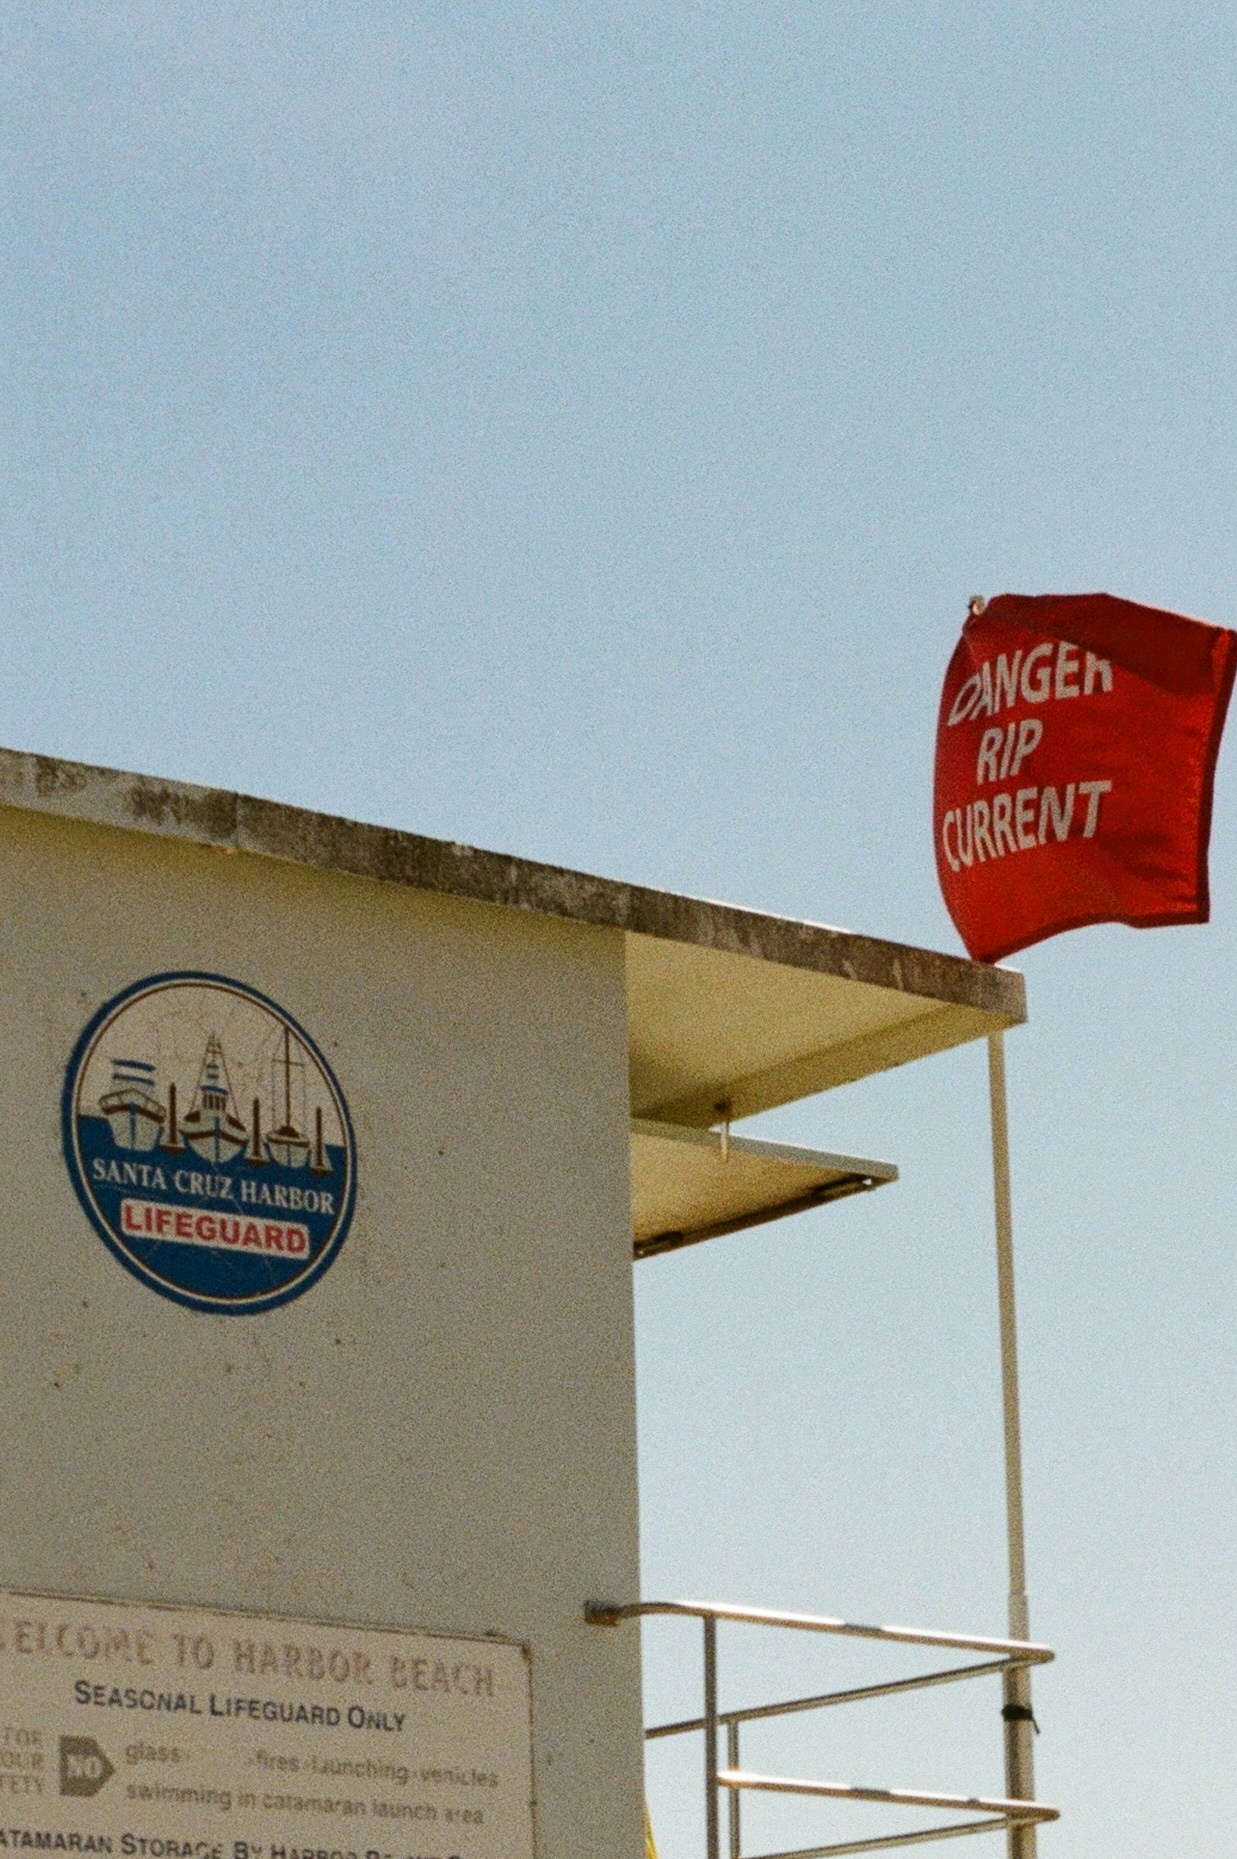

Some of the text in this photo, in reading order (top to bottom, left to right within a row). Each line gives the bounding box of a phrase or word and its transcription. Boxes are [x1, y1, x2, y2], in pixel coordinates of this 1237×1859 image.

[948, 640, 1113, 726] DANGER
[977, 718, 1043, 785] RIP
[943, 780, 1112, 872] CURRENT
[93, 1157, 335, 1216] SANTA CRUZ HARBOR
[124, 1204, 307, 1254] LIFEGUARD
[172, 1633, 216, 1670] TO
[233, 1638, 374, 1686] HARBOR
[390, 1654, 496, 1698] BEACH
[65, 1753, 103, 1780] NO
[125, 1740, 181, 1766] glass
[126, 1780, 232, 1812] swimming
[237, 1787, 257, 1807] in
[263, 1794, 367, 1818] catamaran
[372, 1800, 437, 1822] launch
